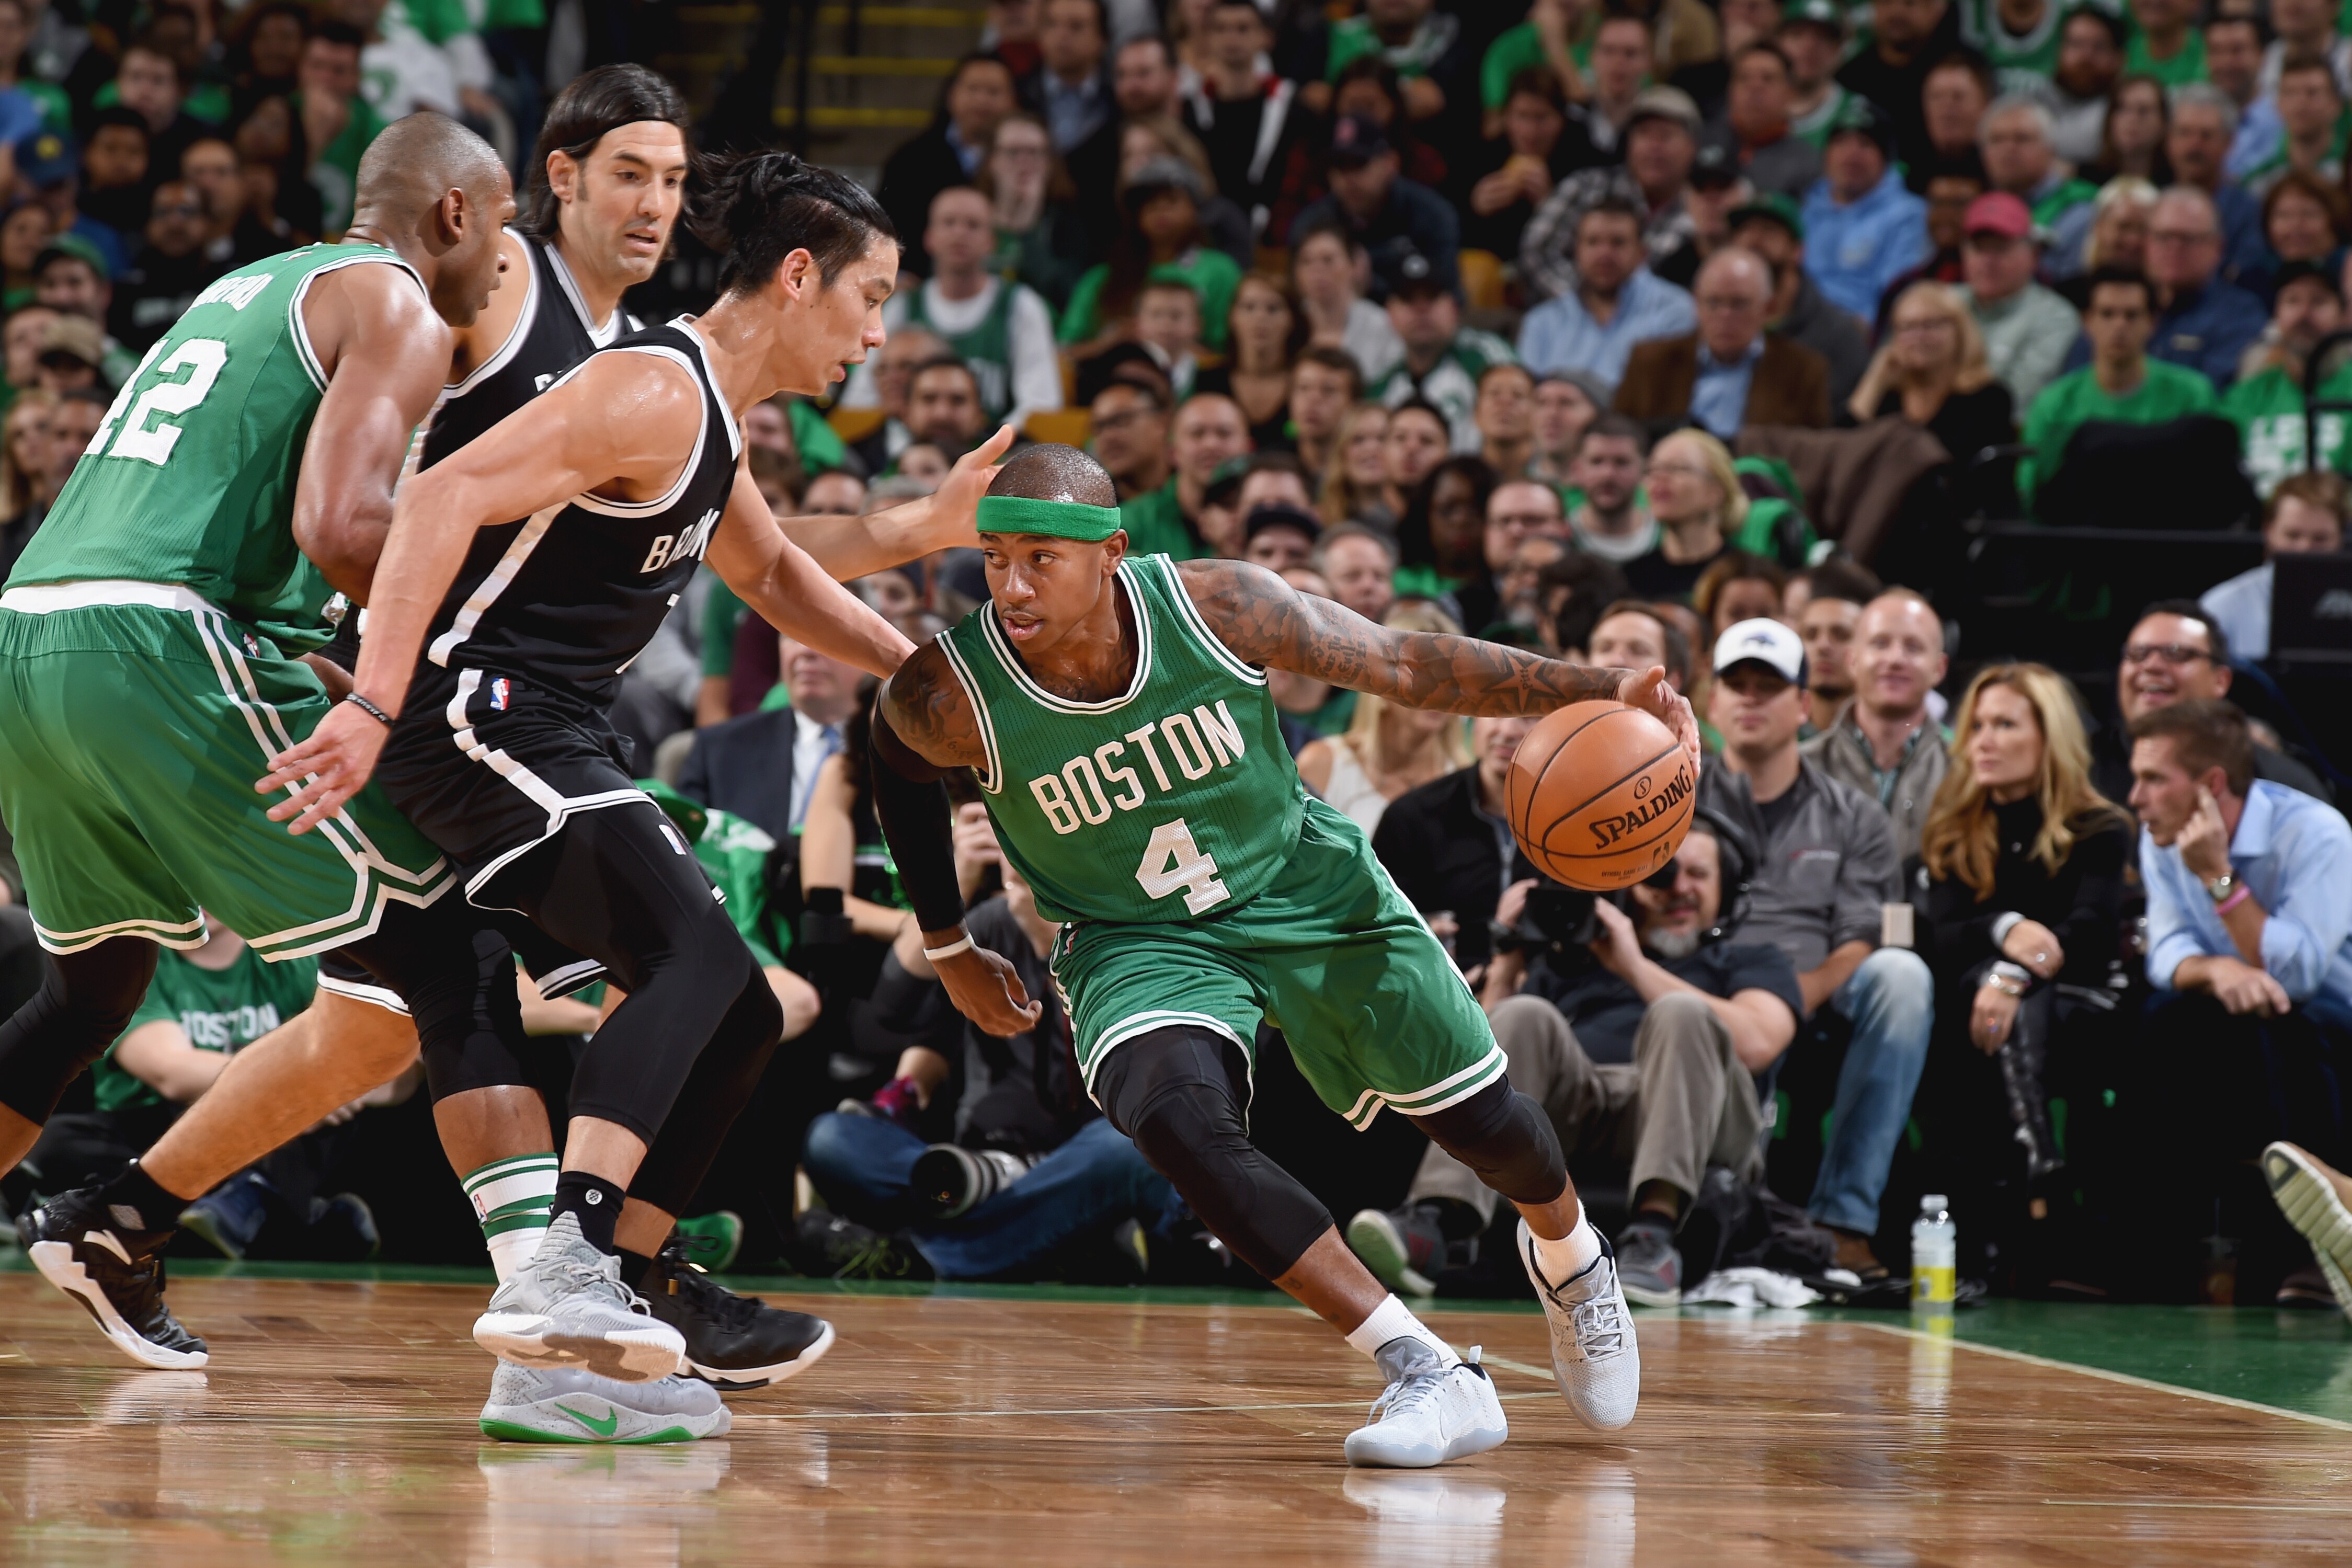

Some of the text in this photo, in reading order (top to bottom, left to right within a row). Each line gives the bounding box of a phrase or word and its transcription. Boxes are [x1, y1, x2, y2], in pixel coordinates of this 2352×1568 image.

[1028, 699, 1246, 835] BOSTON
[1589, 764, 1692, 851] SPALDING
[1135, 817, 1231, 916] 4
